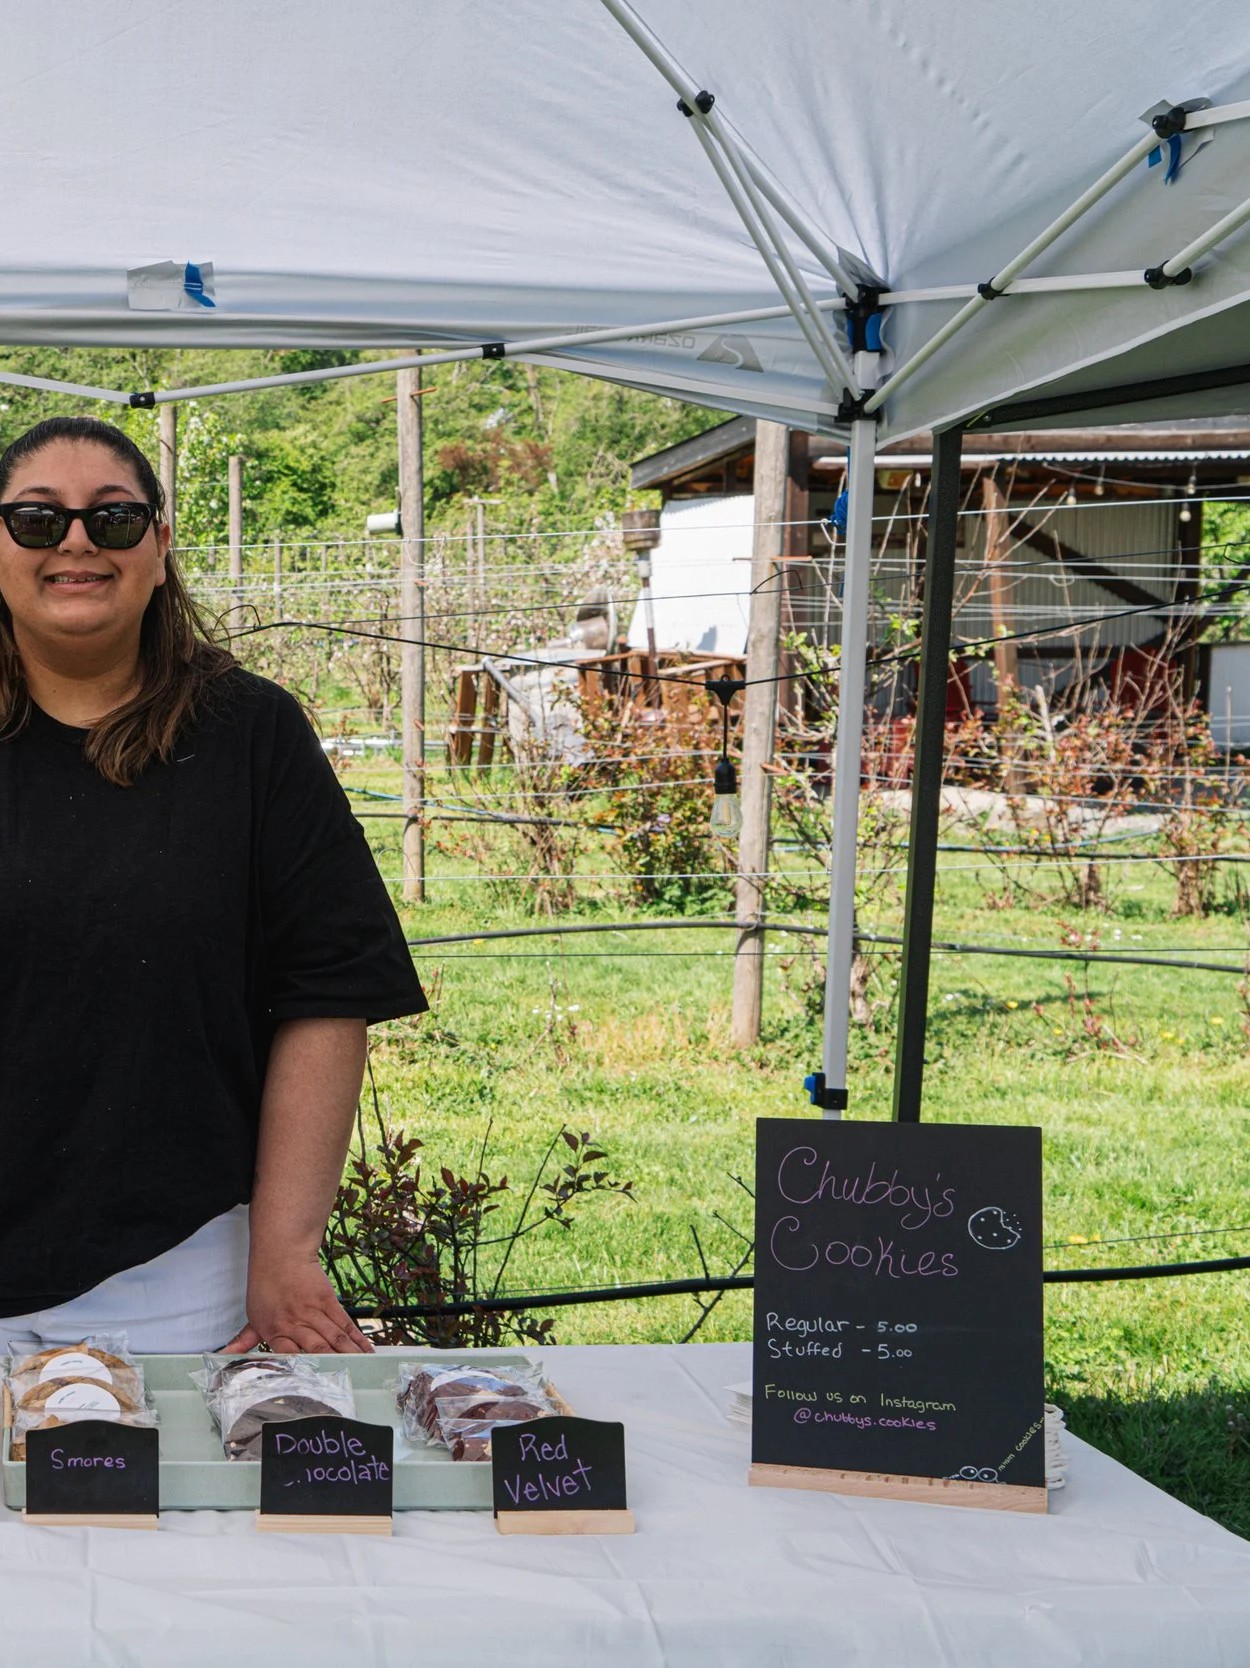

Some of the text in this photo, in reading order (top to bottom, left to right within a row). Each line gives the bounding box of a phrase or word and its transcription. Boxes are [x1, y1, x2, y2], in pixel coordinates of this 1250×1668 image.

[778, 1146, 956, 1230] Chubby's
[770, 1215, 959, 1279] Cookies
[766, 1312, 850, 1338] Regular
[877, 1321, 918, 1333] 5.00
[768, 1338, 842, 1358] Stuffed
[878, 1344, 912, 1359] 5.00
[765, 1384, 956, 1413] Follow us on Instagram
[793, 1407, 937, 1431] @chubbys.cookies
[275, 1429, 367, 1458] Double
[519, 1433, 569, 1462] Red
[51, 1448, 127, 1470] Smores
[284, 1455, 390, 1487] ocolate
[504, 1458, 592, 1504] Velvet
